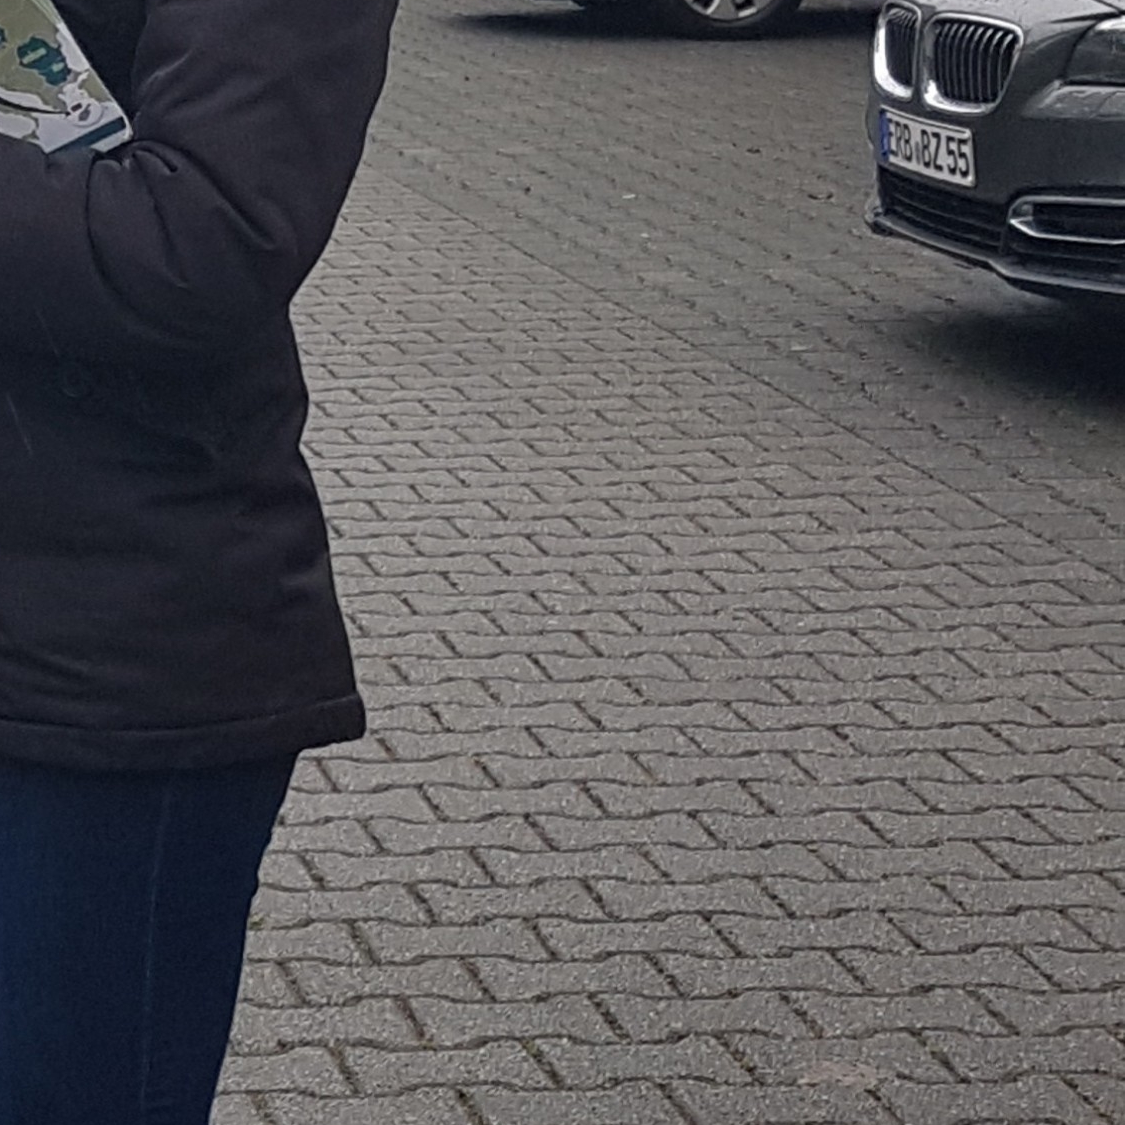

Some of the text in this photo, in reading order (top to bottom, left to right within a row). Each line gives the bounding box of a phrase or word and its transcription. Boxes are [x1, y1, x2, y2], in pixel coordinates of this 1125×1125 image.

[888, 117, 970, 179] ERB BZ 55
